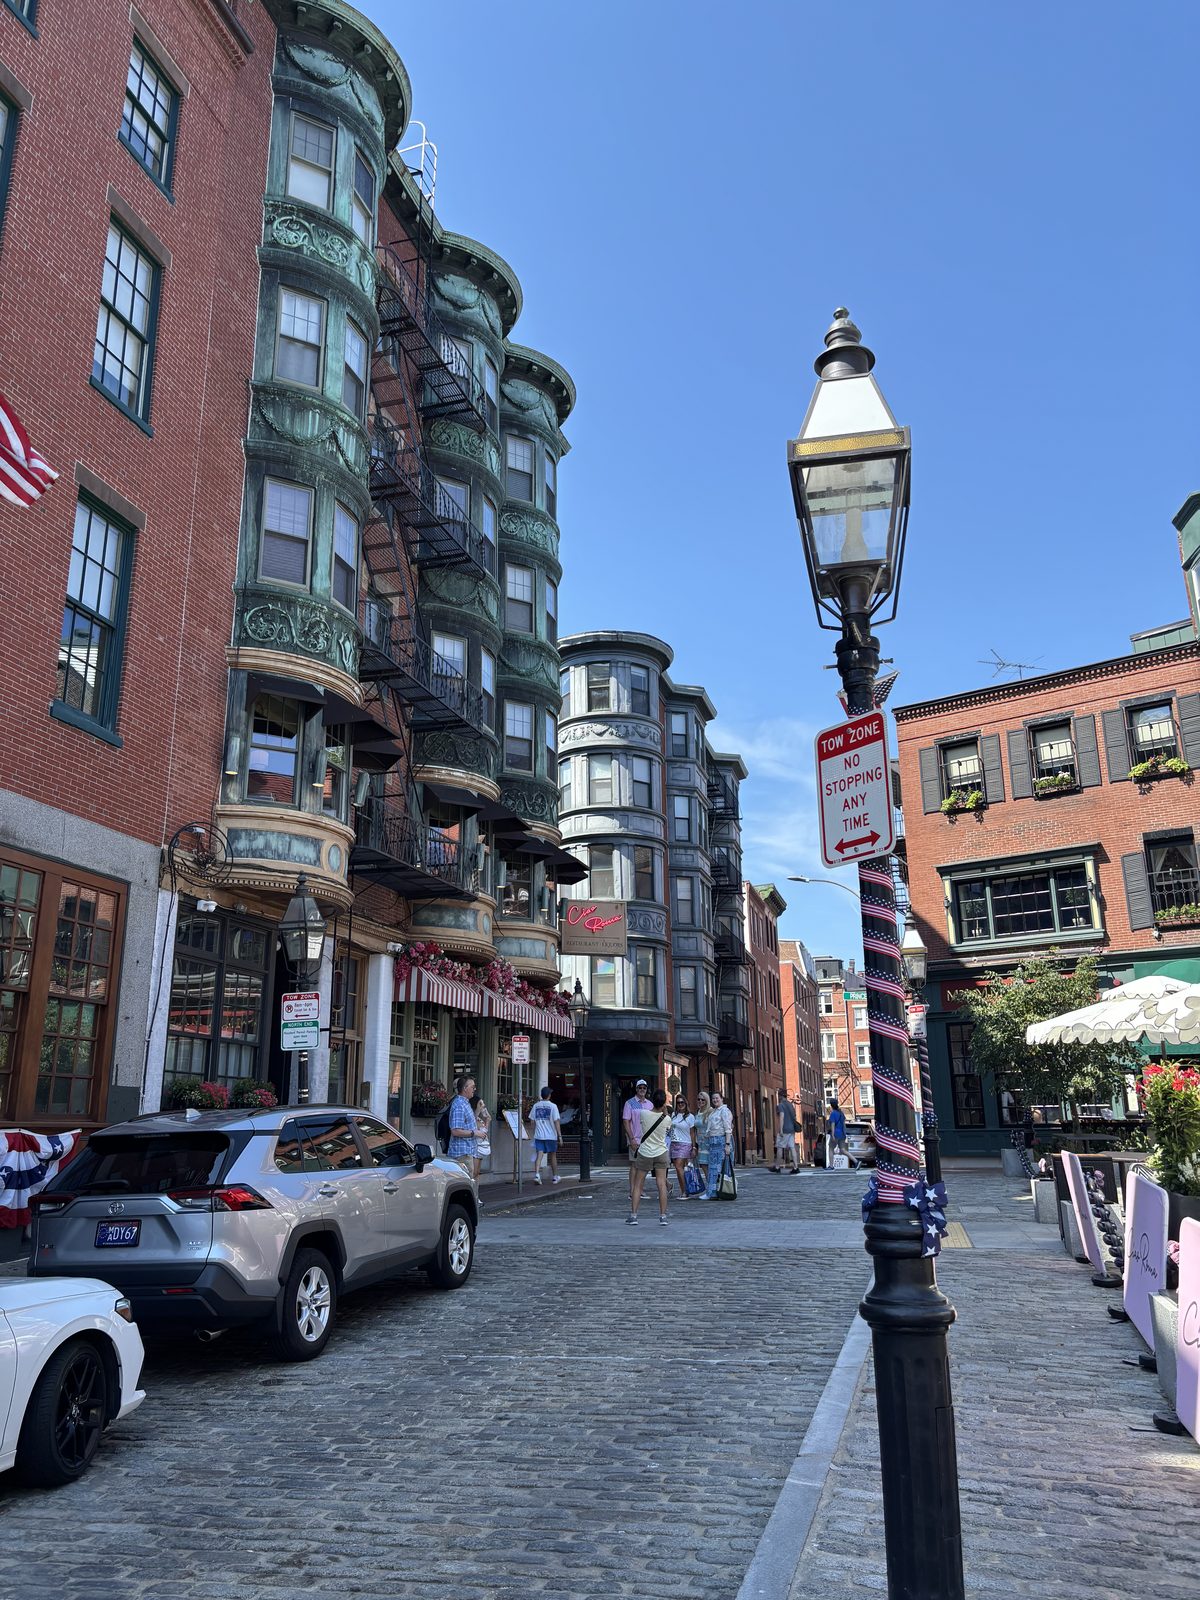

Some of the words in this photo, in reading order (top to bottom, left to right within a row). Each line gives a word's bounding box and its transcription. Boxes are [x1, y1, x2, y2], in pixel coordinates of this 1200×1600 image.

[821, 734, 844, 753] TOW
[849, 720, 880, 744] ZONE
[844, 753, 860, 770] NO
[825, 766, 883, 796] STOPPING
[842, 791, 867, 812] ANY
[842, 812, 870, 832] TIME
[568, 904, 598, 925] Ciao
[584, 914, 623, 933] Roma
